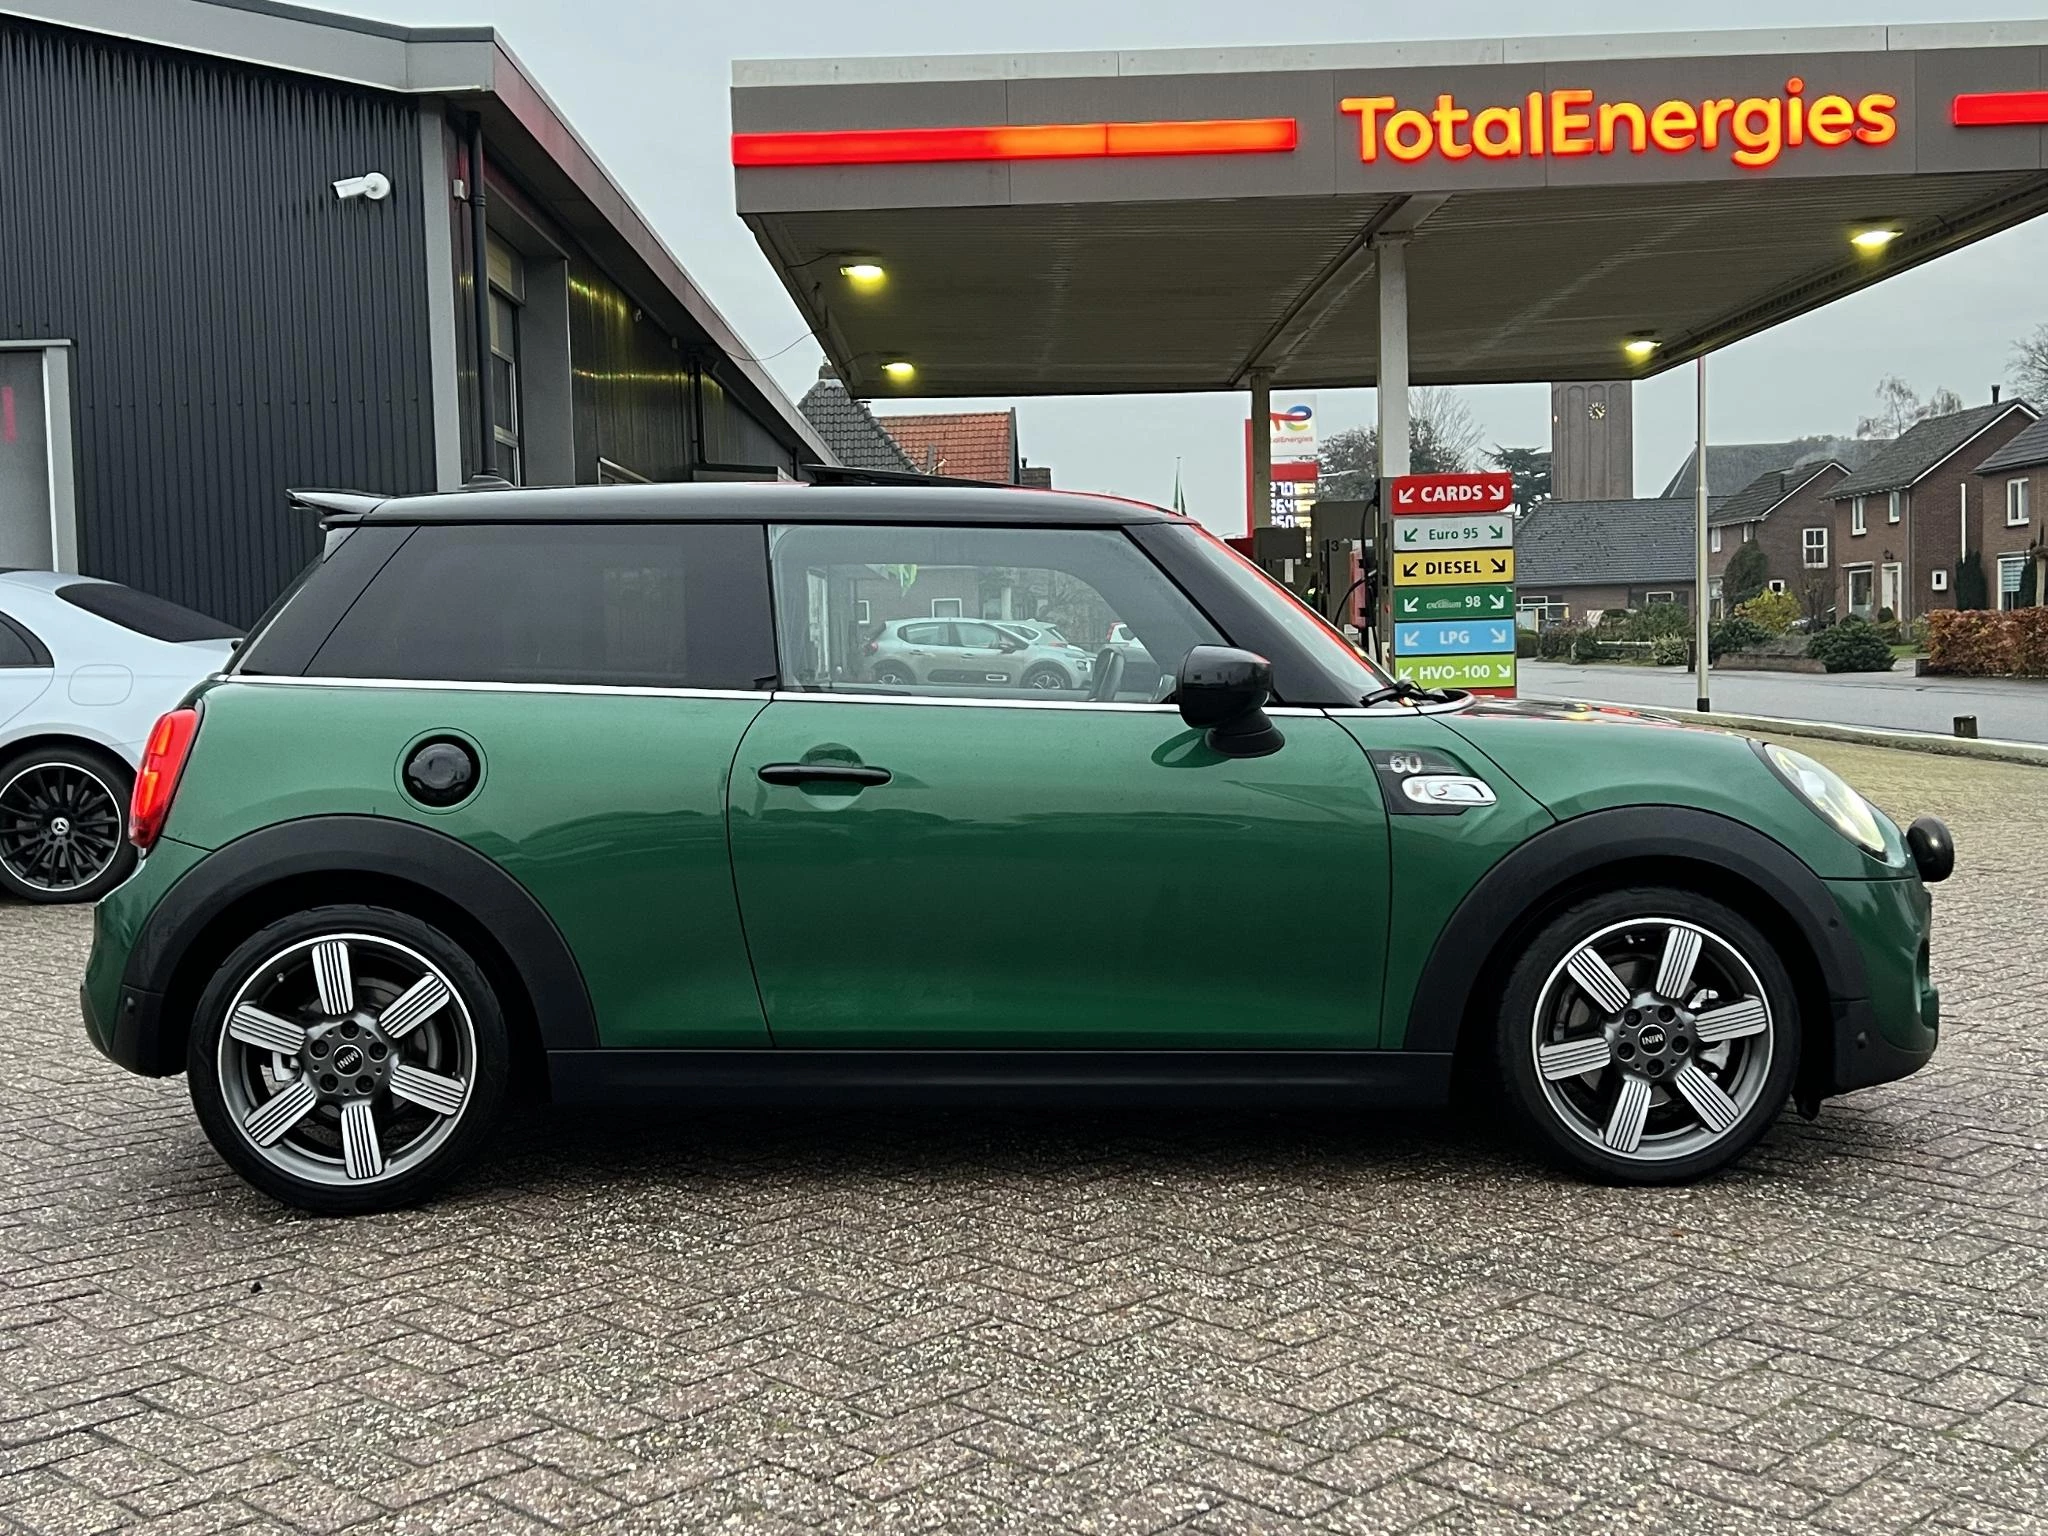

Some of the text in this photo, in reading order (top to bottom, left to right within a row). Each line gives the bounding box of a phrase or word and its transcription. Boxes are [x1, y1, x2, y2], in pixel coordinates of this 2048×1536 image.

[1341, 77, 1897, 166] TotalEnergies
[1420, 484, 1483, 503] CARDS
[1429, 527, 1479, 541] Euro 95
[1331, 540, 1340, 552] 3
[1425, 560, 1482, 575] DIESEL
[1465, 595, 1481, 608] 98
[1439, 630, 1470, 644] LPG
[1419, 664, 1490, 679] HVO-100
[1389, 752, 1422, 774] 60
[1641, 1033, 1664, 1046] MINI
[337, 1050, 359, 1069] MINI
